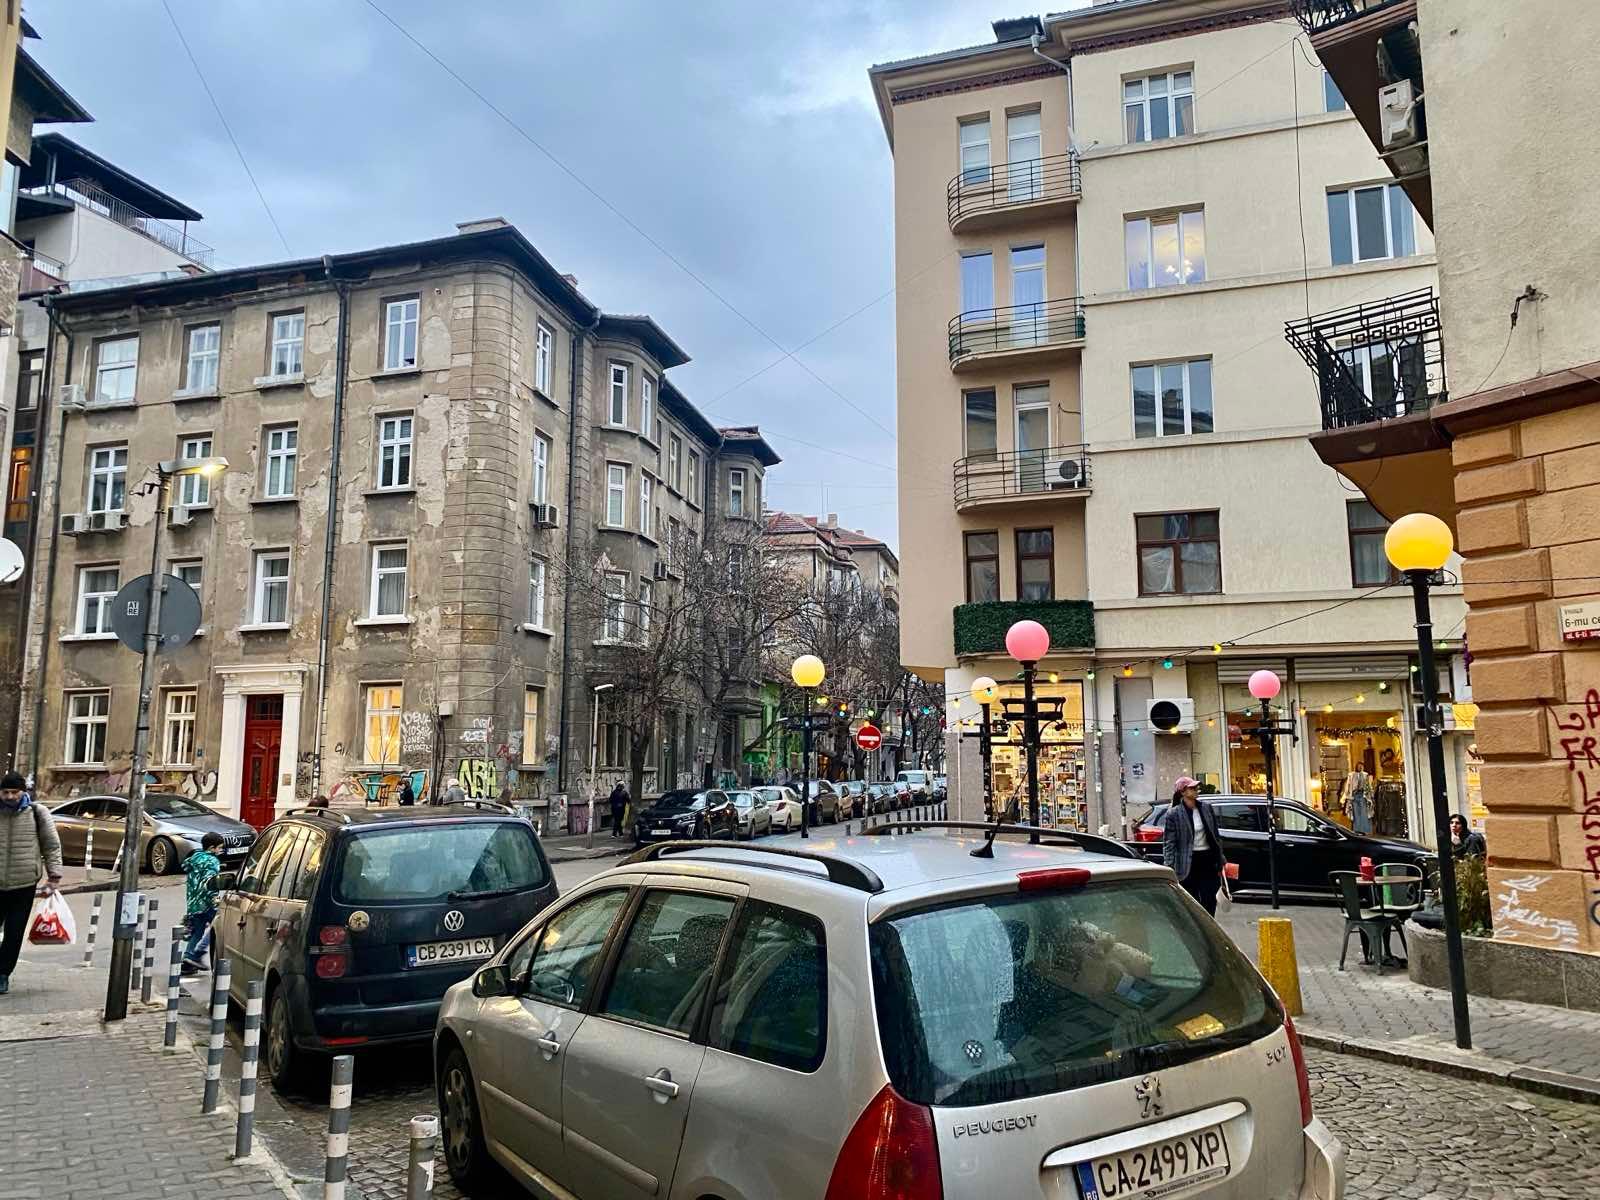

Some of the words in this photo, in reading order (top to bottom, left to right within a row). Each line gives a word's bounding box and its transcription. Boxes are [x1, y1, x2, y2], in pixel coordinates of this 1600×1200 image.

[418, 945, 437, 961] CB
[439, 942, 471, 958] 2391
[474, 938, 492, 954] CX
[952, 1114, 1037, 1139] PEUGEOT
[1098, 1158, 1133, 1198] CA
[1133, 1141, 1188, 1189] 2499
[1190, 1131, 1220, 1170] XP
